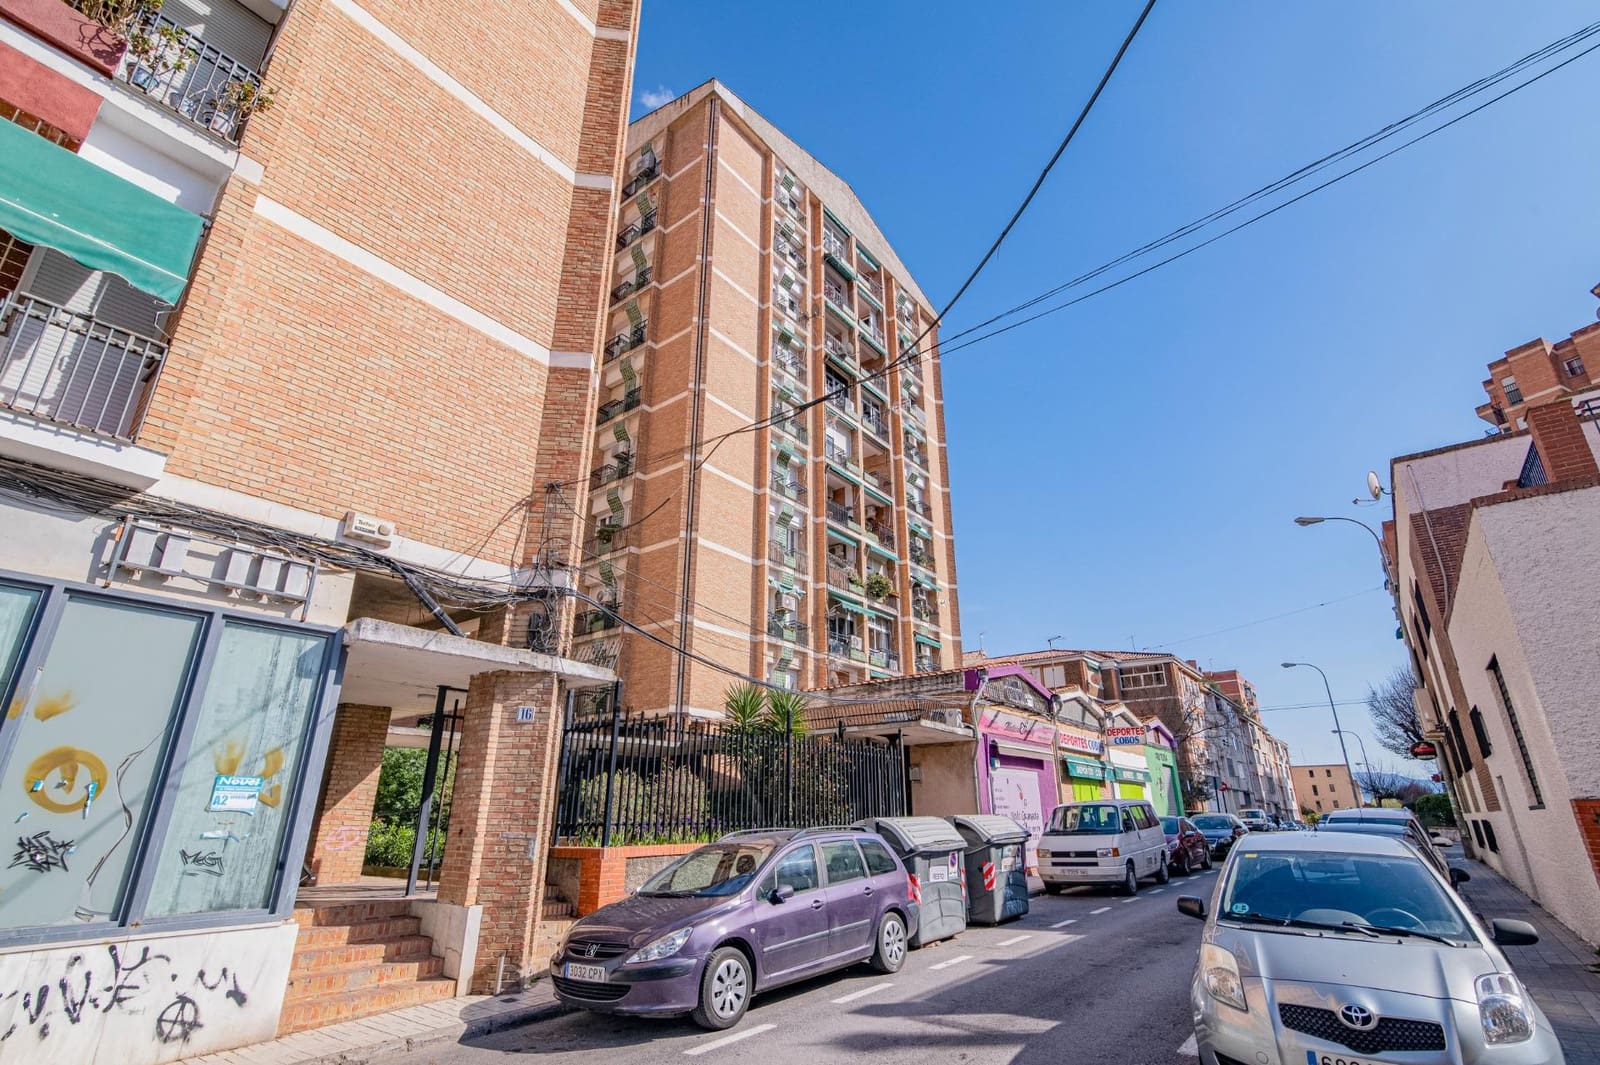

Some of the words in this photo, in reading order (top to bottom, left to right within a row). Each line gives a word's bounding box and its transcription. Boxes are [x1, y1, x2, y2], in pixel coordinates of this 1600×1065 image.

[521, 708, 532, 720] 16
[1106, 727, 1145, 737] DEPORTES
[1059, 732, 1088, 749] DEPORTES
[1114, 736, 1140, 745] COBOS
[570, 965, 587, 979] 3032
[588, 967, 603, 980] CPX
